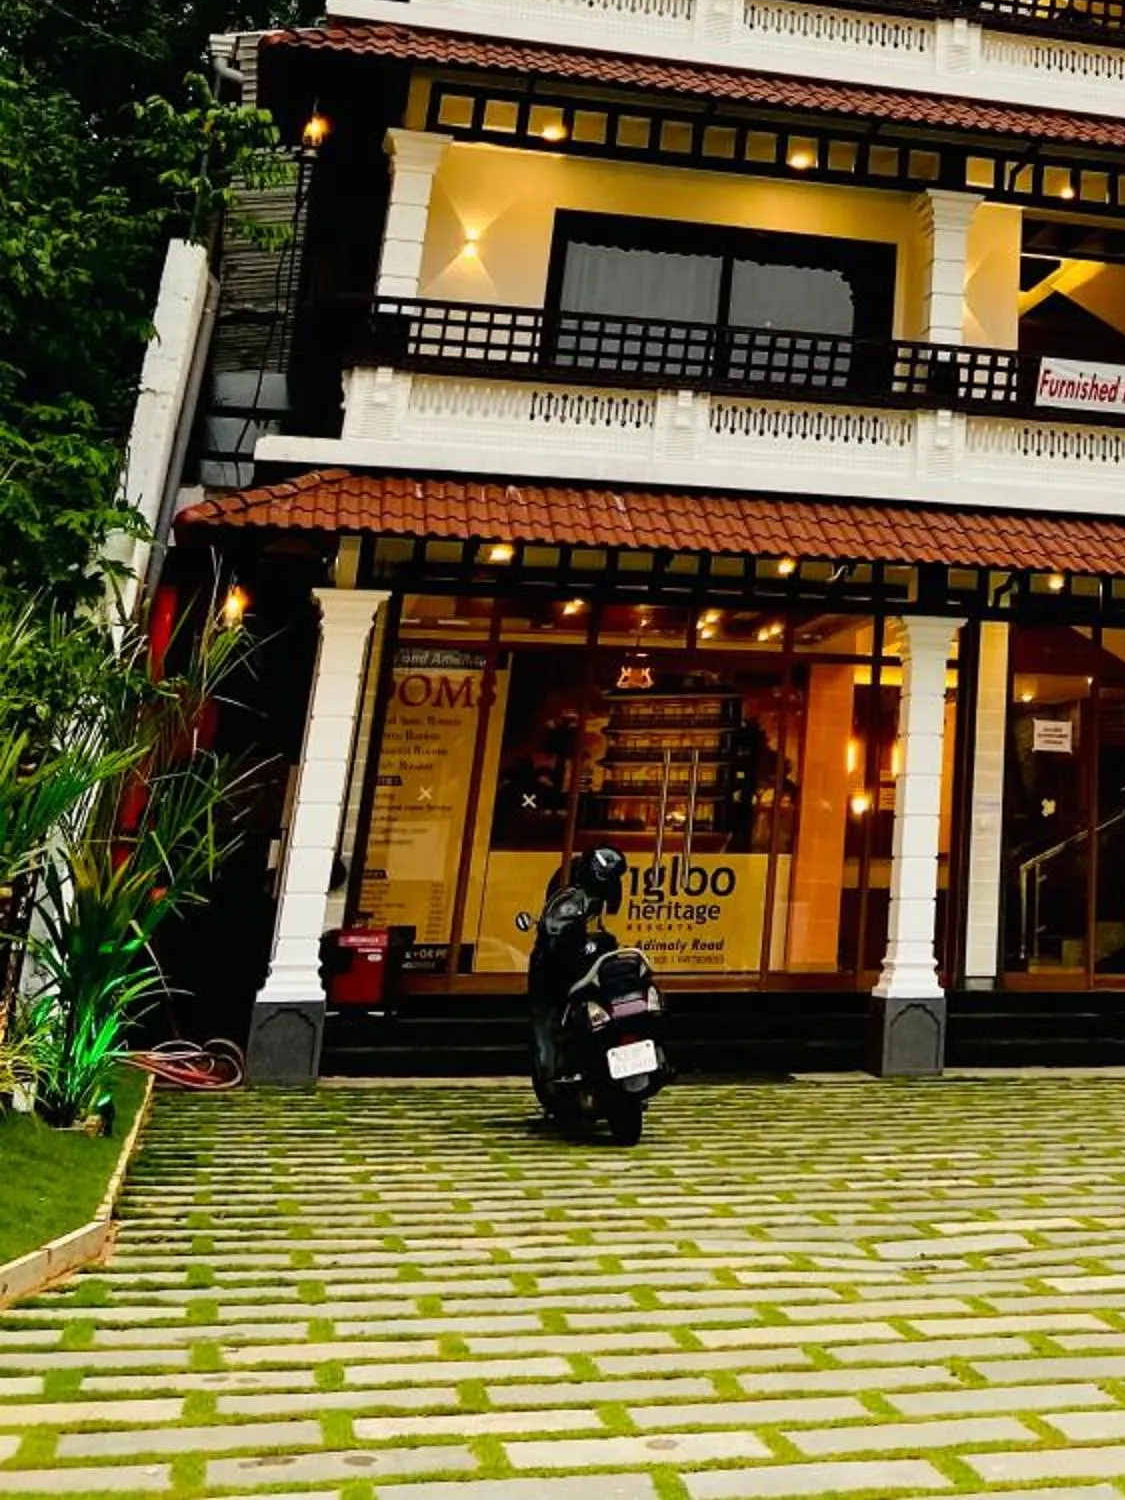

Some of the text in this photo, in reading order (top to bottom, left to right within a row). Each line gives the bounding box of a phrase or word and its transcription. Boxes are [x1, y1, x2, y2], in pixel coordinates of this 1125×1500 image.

[1040, 369, 1121, 403] Furnished
[629, 856, 736, 904] igloo
[627, 900, 721, 925] heritage
[691, 938, 725, 951] Road
